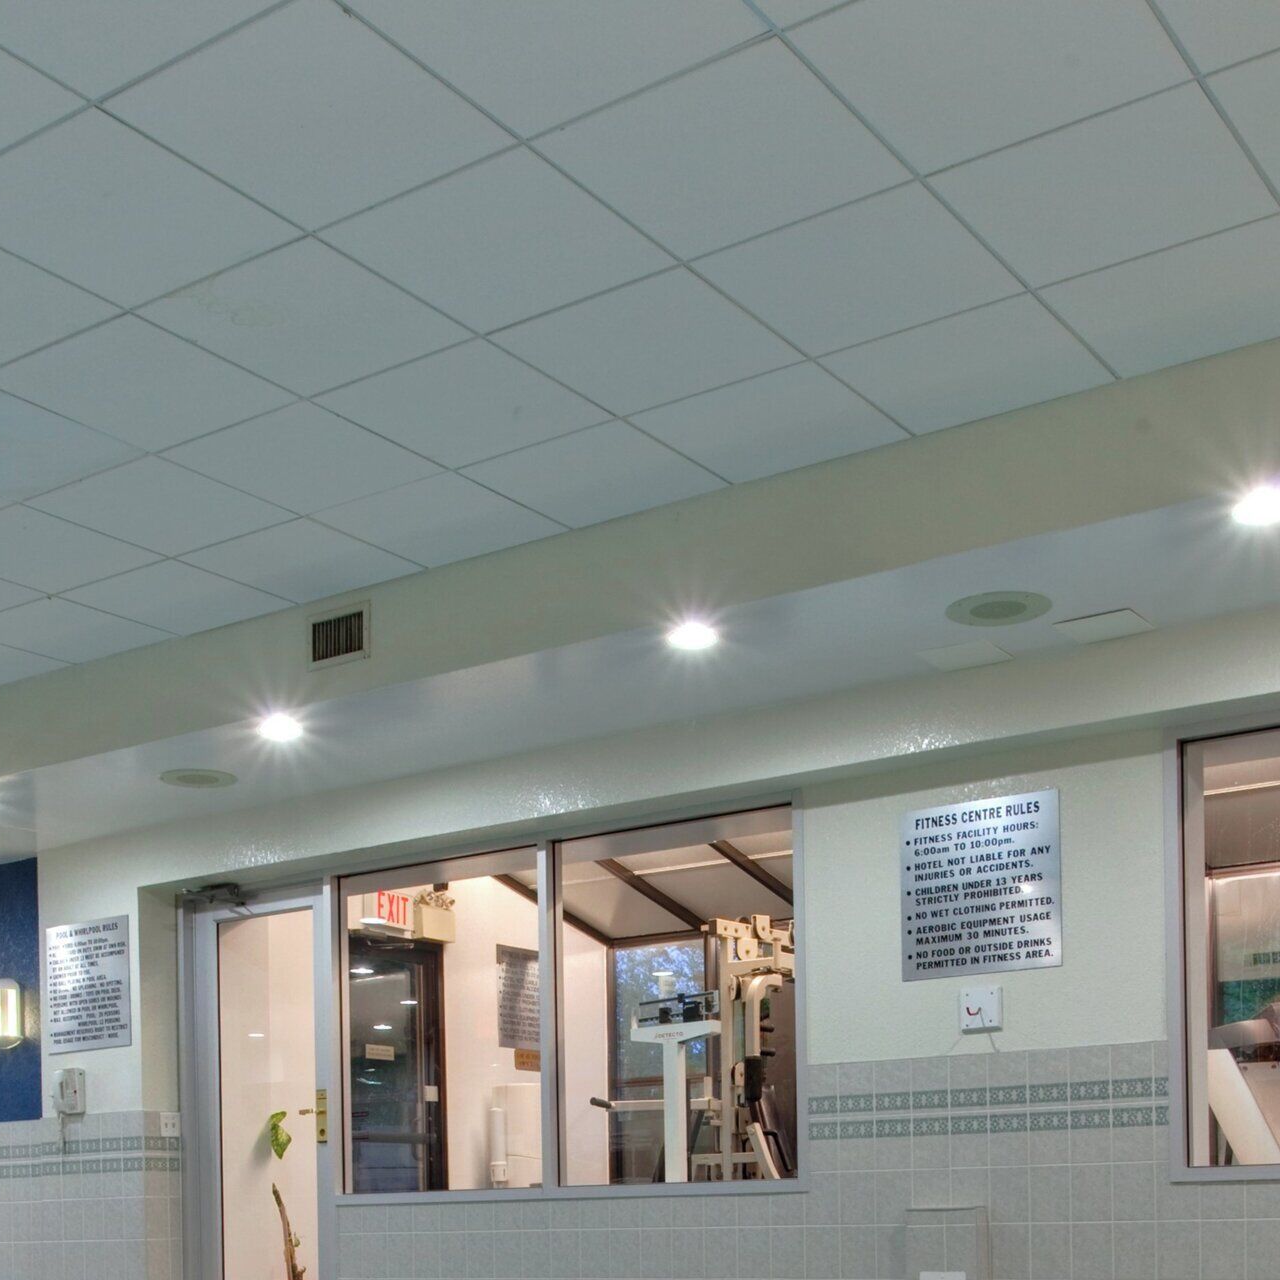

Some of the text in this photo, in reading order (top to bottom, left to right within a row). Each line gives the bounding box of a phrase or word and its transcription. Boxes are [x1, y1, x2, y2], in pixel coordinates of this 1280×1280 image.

[916, 801, 1040, 830] FITNESS CENTRE RULES
[914, 821, 1039, 846] FITNESS FACILITY HOURS:
[914, 836, 1014, 857] 6:00am TO 10:00pm.
[915, 845, 1051, 871] HOTEL NOT LIABLE FOR ANY
[915, 859, 1033, 882] INJURIES OR ACCIDENTS.
[915, 872, 1043, 896] CHILDREN UNDER 13 YEARS
[377, 888, 409, 925] EXIT
[916, 894, 959, 906] STRICTLY
[916, 896, 1055, 920] NO WET CLOTHING PERMITTED.
[74, 925, 101, 936] WHIRLPOOL
[102, 922, 118, 932] RULES
[916, 912, 1051, 935] AEROBIC EQUIPMENT USAGE
[916, 925, 1029, 946] MAXIMUM 30 MINUTES.
[917, 937, 1052, 960] NO FOOD OR OUTSIDE DRINKS
[917, 948, 1053, 970] PERMITTED IN FITNESS AREA.
